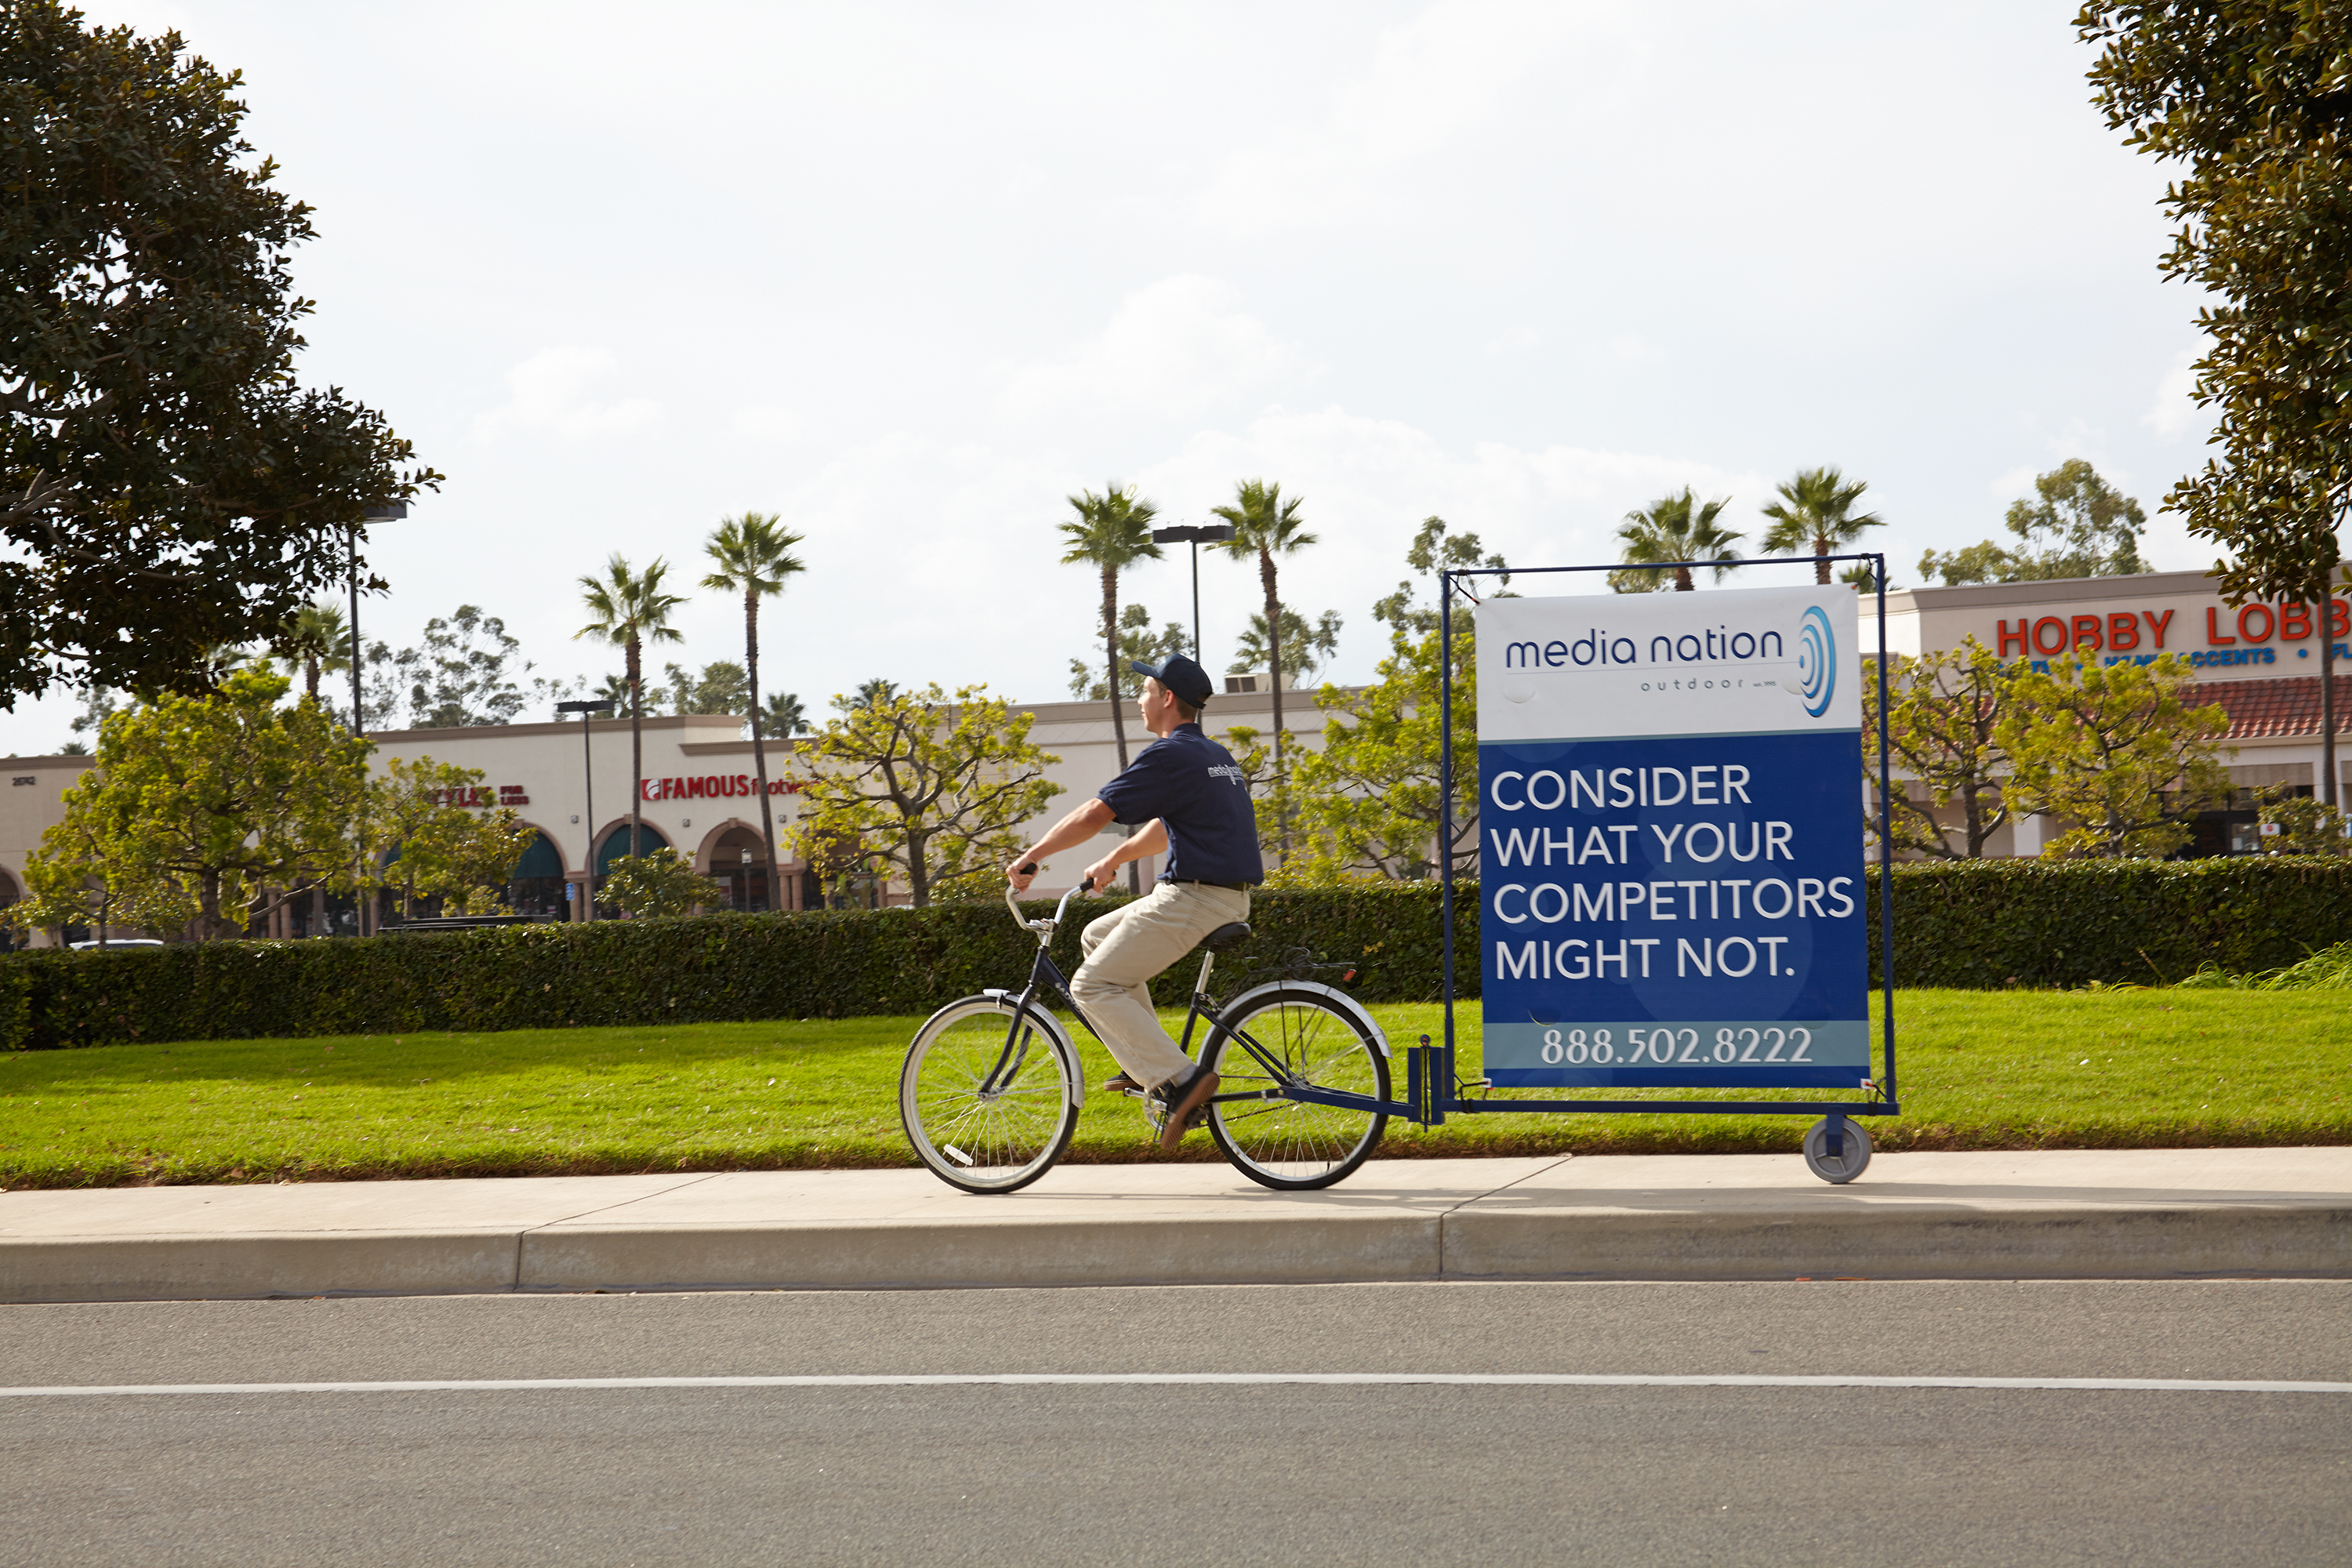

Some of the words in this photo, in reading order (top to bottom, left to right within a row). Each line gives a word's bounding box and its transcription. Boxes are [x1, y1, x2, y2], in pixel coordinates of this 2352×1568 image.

[1506, 628, 1636, 668] media
[1650, 625, 1783, 662] nation
[1997, 609, 2175, 657] HOBBY
[1640, 677, 1743, 691] outdoor
[499, 785, 523, 795] FOR
[499, 796, 529, 806] LESS
[662, 775, 749, 800] FAMOUS
[1490, 764, 1752, 811] CONSIDER
[1490, 825, 1639, 866] WHAT
[1650, 821, 1795, 863] YOUR
[1494, 876, 1855, 924] COMPETITORS
[1496, 938, 1661, 980] MIGHT
[1677, 936, 1795, 978] NOT.
[1541, 1027, 1813, 1065] 888.502.8222
